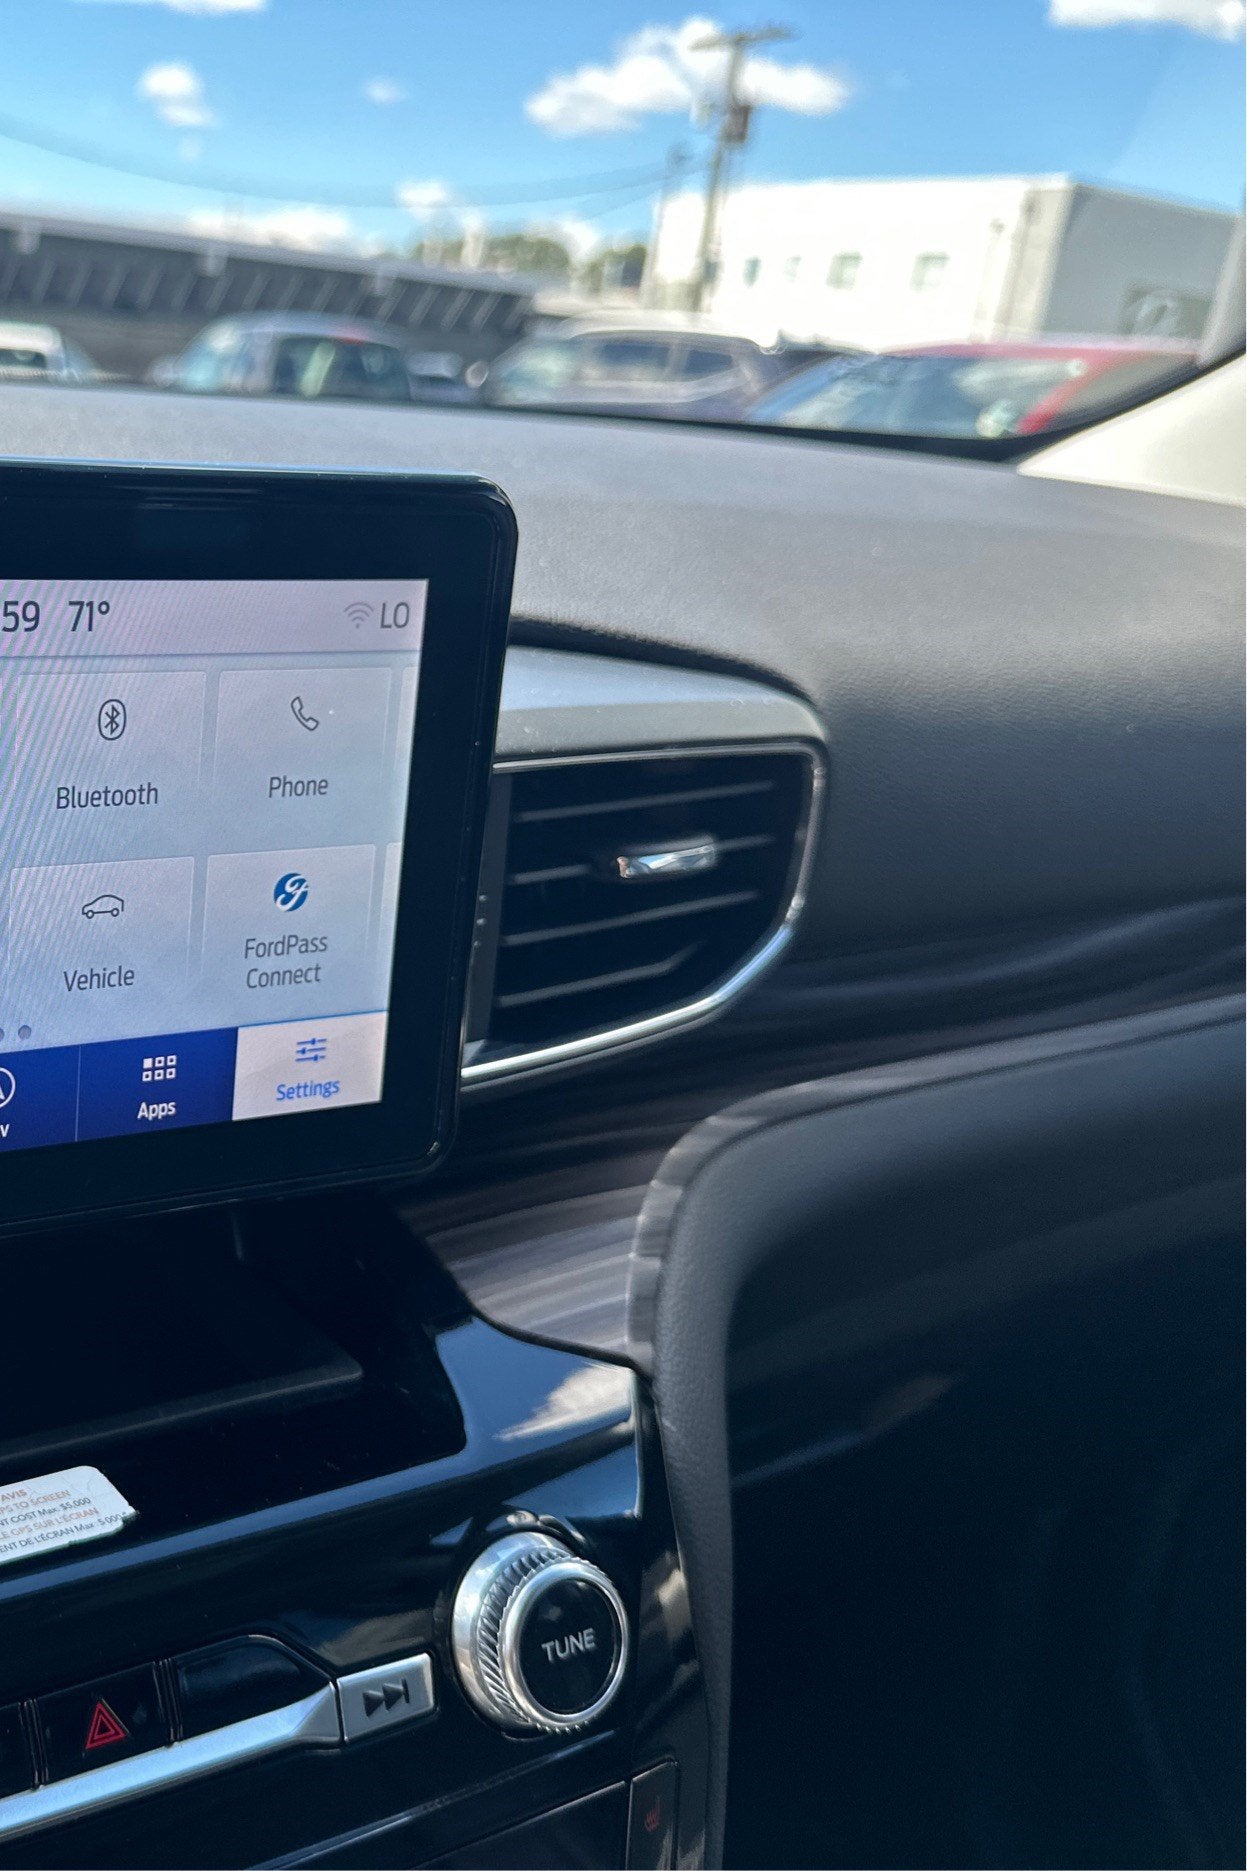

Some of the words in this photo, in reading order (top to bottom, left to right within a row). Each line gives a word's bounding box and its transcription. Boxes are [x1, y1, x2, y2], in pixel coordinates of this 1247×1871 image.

[67, 599, 112, 634] 71°
[379, 601, 411, 630] LO
[55, 782, 159, 810] Bluetooth
[268, 774, 329, 799] Phone
[243, 933, 329, 960] FordPass
[62, 965, 136, 993] Vehicle
[245, 961, 322, 990] Connect
[275, 1076, 341, 1102] Settings
[136, 1099, 177, 1123] Apps
[13, 1499, 30, 1510] TO
[29, 1489, 72, 1507] SCREEN
[10, 1510, 38, 1524] COST
[10, 1525, 34, 1538] GPS
[33, 1517, 57, 1531] SUR
[19, 1537, 35, 1548] DE
[541, 1628, 597, 1664] TUNE
